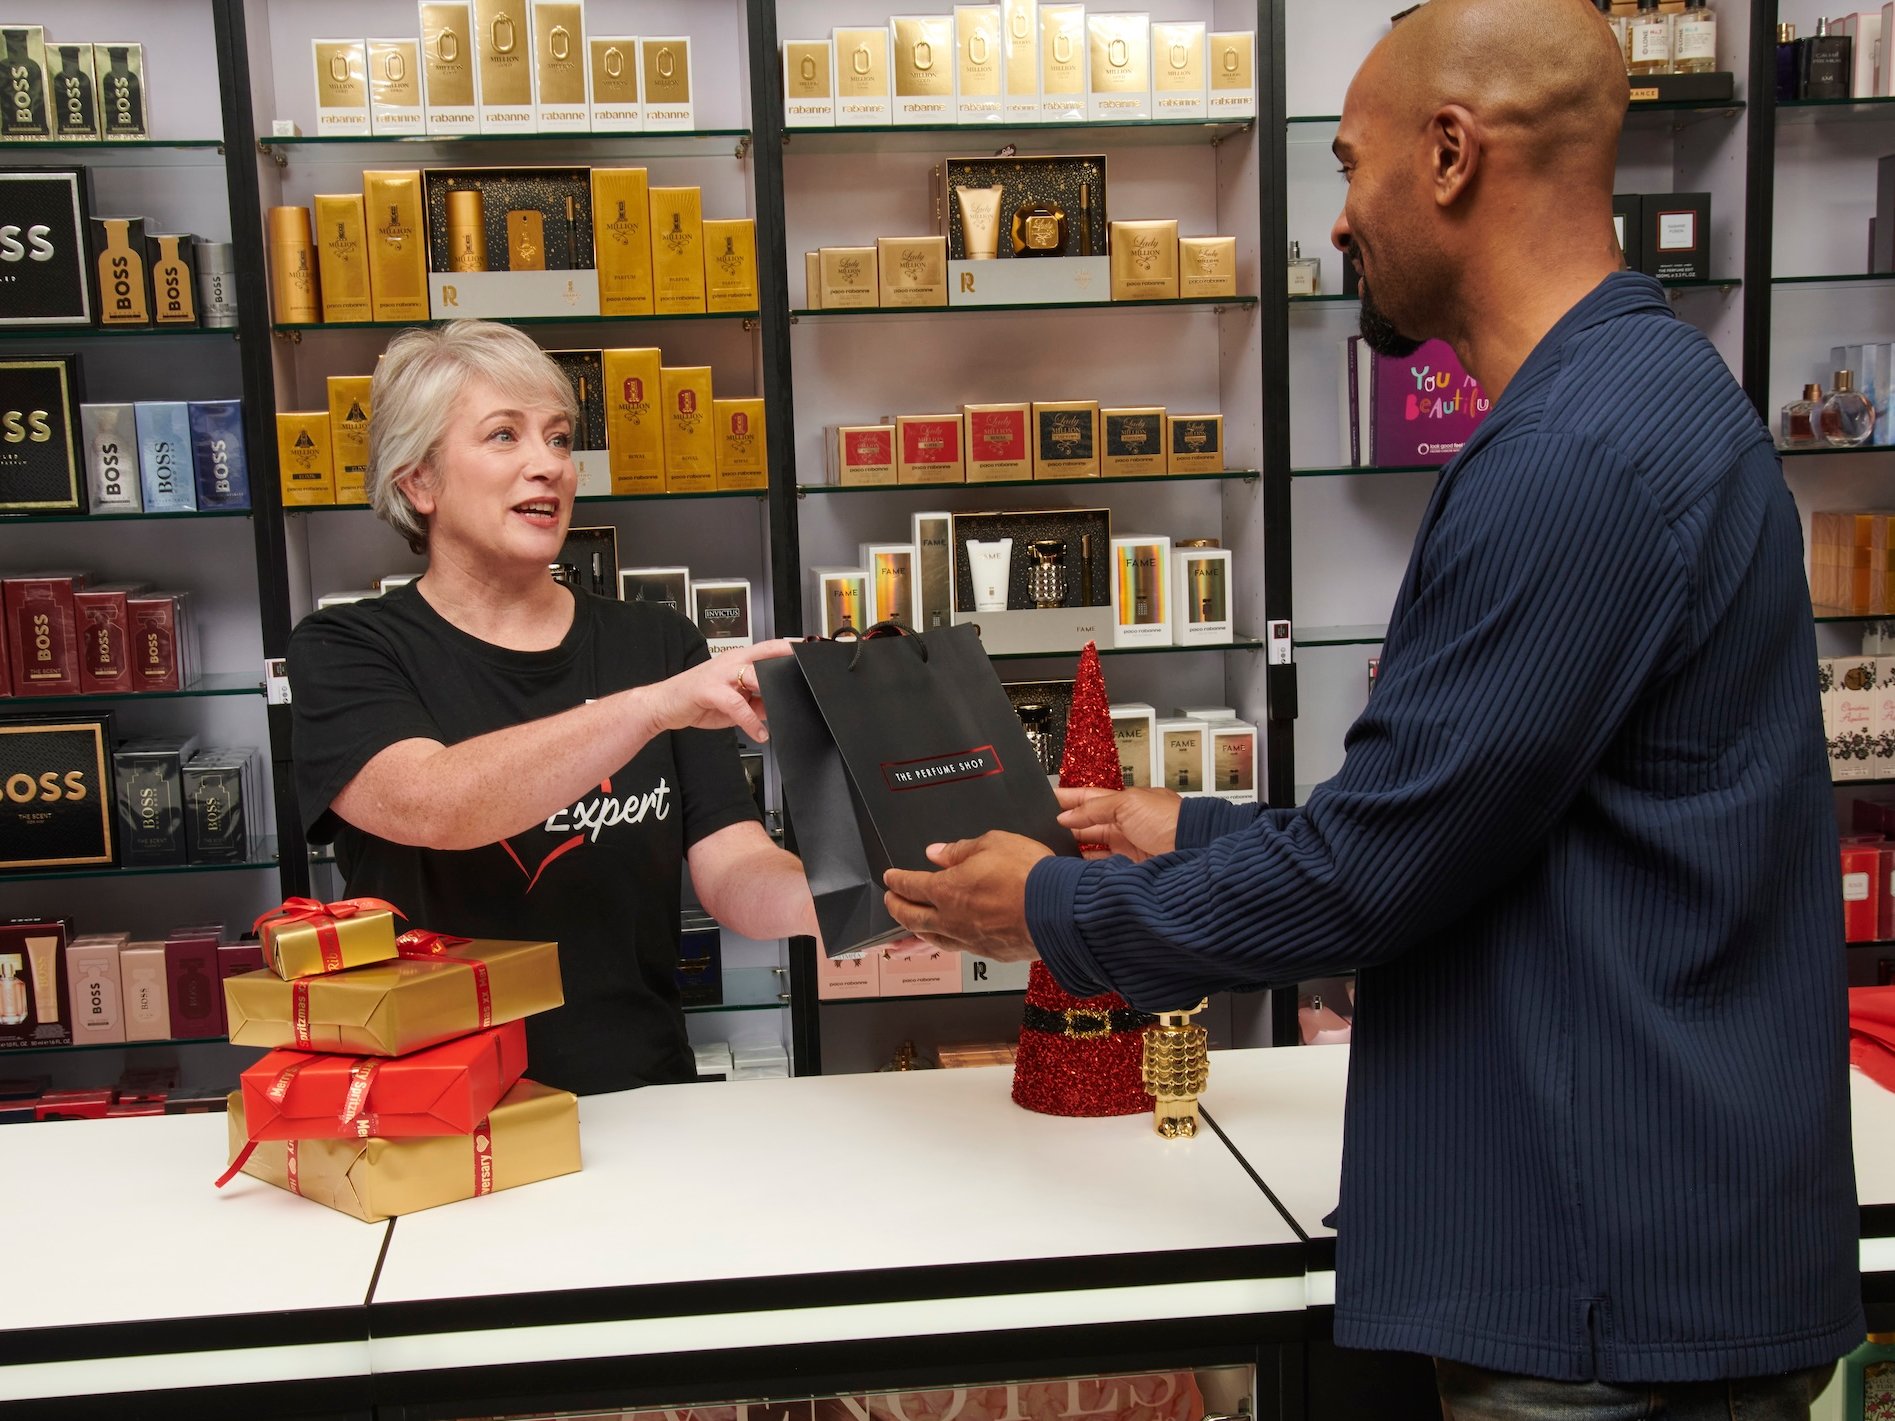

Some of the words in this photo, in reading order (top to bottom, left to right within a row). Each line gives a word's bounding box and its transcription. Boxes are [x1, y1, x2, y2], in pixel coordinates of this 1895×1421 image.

[12, 66, 33, 122] BOSS
[65, 77, 83, 124] BOSS
[114, 77, 132, 124] BOSS
[1098, 99, 1141, 108] rabanne
[1158, 98, 1201, 107] rabanne
[1210, 97, 1253, 105] rabanne
[486, 111, 530, 121] rabanne
[542, 110, 585, 120] rabanne
[595, 110, 638, 120] rabanne
[647, 110, 689, 120] rabanne
[789, 105, 831, 114] rabanne
[842, 104, 885, 113] rabanne
[904, 103, 945, 112] rabanne
[959, 103, 1002, 112] rabanne
[1006, 103, 1037, 111] rabanne
[1043, 101, 1085, 110] rabanne
[321, 115, 366, 124] rabanne
[376, 113, 421, 123] rabanne
[431, 113, 474, 122] rabanne
[0, 225, 54, 261] SS
[1134, 236, 1158, 250] Lady
[839, 258, 860, 269] Lady
[902, 249, 925, 262] Lady
[112, 256, 132, 310] BOSS
[165, 266, 181, 311] BOSS
[213, 276, 222, 303] BOSS
[1411, 366, 1451, 392] You
[1405, 387, 1493, 421] Beautifu
[3, 410, 51, 443] SS
[1054, 413, 1079, 427] Lady
[1123, 418, 1145, 430] Lady
[1186, 422, 1206, 432] Lady
[103, 443, 121, 495] BOSS
[155, 442, 173, 493] BOSS
[211, 440, 230, 492] BOSS
[1126, 558, 1156, 568] FAME
[1194, 568, 1219, 576] FAME
[834, 589, 858, 597] FAME
[34, 614, 51, 661] BOSS
[98, 629, 110, 663] BOSS
[148, 633, 159, 664] BOSS
[1113, 729, 1142, 738] FAME
[1171, 740, 1196, 748] FAME
[895, 772, 912, 782] THE
[915, 764, 956, 779] PERFUME
[959, 758, 984, 772] SHOP
[0, 771, 86, 803] OSS
[140, 788, 155, 829] BOSS
[206, 797, 219, 831] BOSS
[545, 777, 670, 843] Expert
[37, 956, 49, 989] BOSS
[91, 982, 102, 1014] BOSS
[140, 988, 148, 1010] BOSS
[296, 995, 310, 1047] Spritzmas
[354, 1059, 377, 1081] erry
[270, 1070, 295, 1097] Merry
[344, 1081, 367, 1124] Spritzm
[479, 1154, 492, 1196] versary
